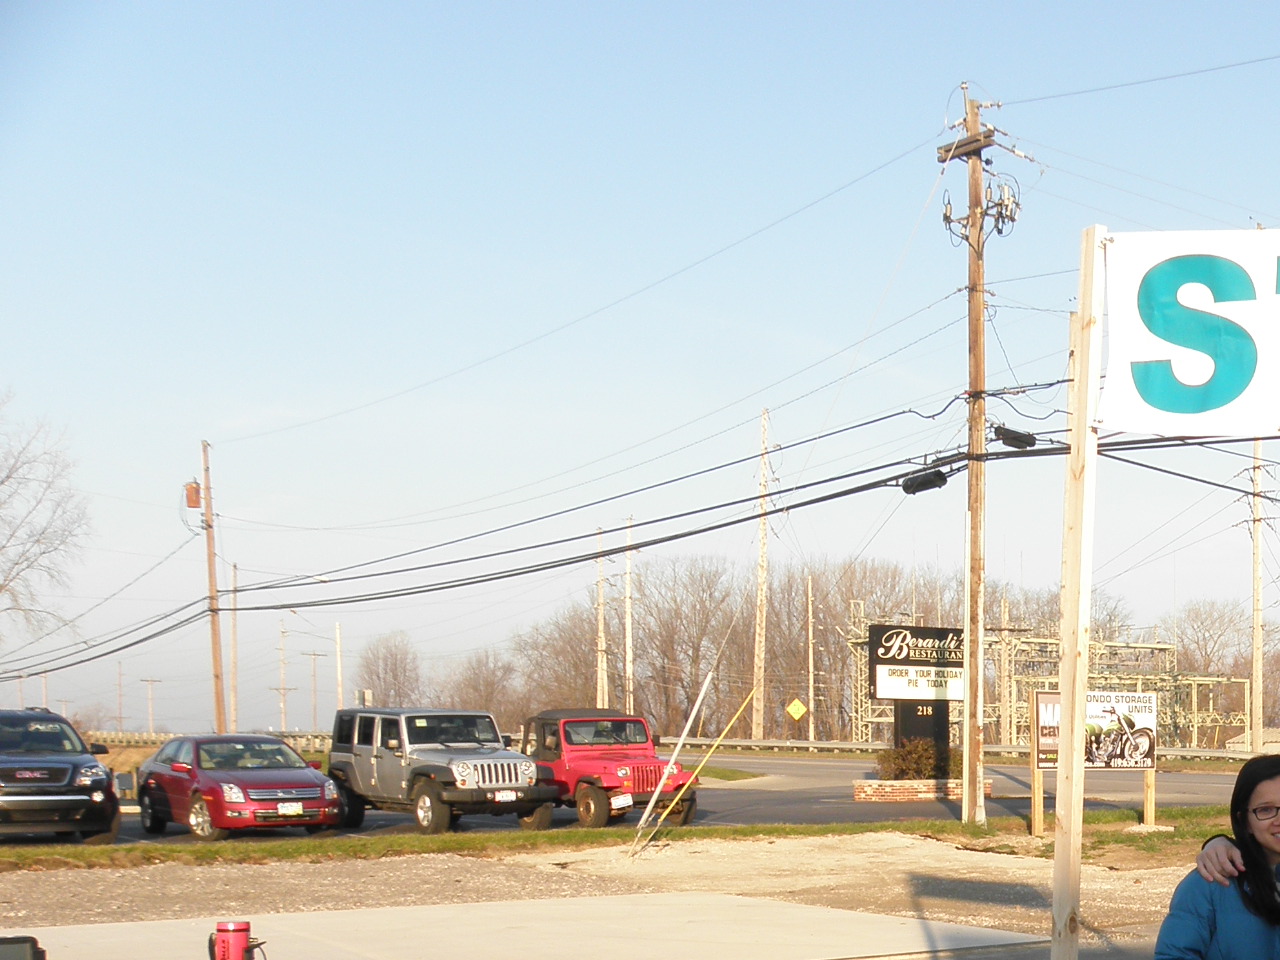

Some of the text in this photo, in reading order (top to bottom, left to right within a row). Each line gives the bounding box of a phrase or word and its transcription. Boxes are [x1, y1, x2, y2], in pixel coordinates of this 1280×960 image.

[909, 649, 963, 659] RESTAURAN
[888, 668, 963, 679] ORDER YOUR HOLIDAY
[908, 679, 948, 688] PIE TODAY
[1115, 695, 1153, 704] STORAGE
[917, 706, 933, 715] 218
[1128, 705, 1153, 713] UNITS
[16, 770, 49, 778] GMC
